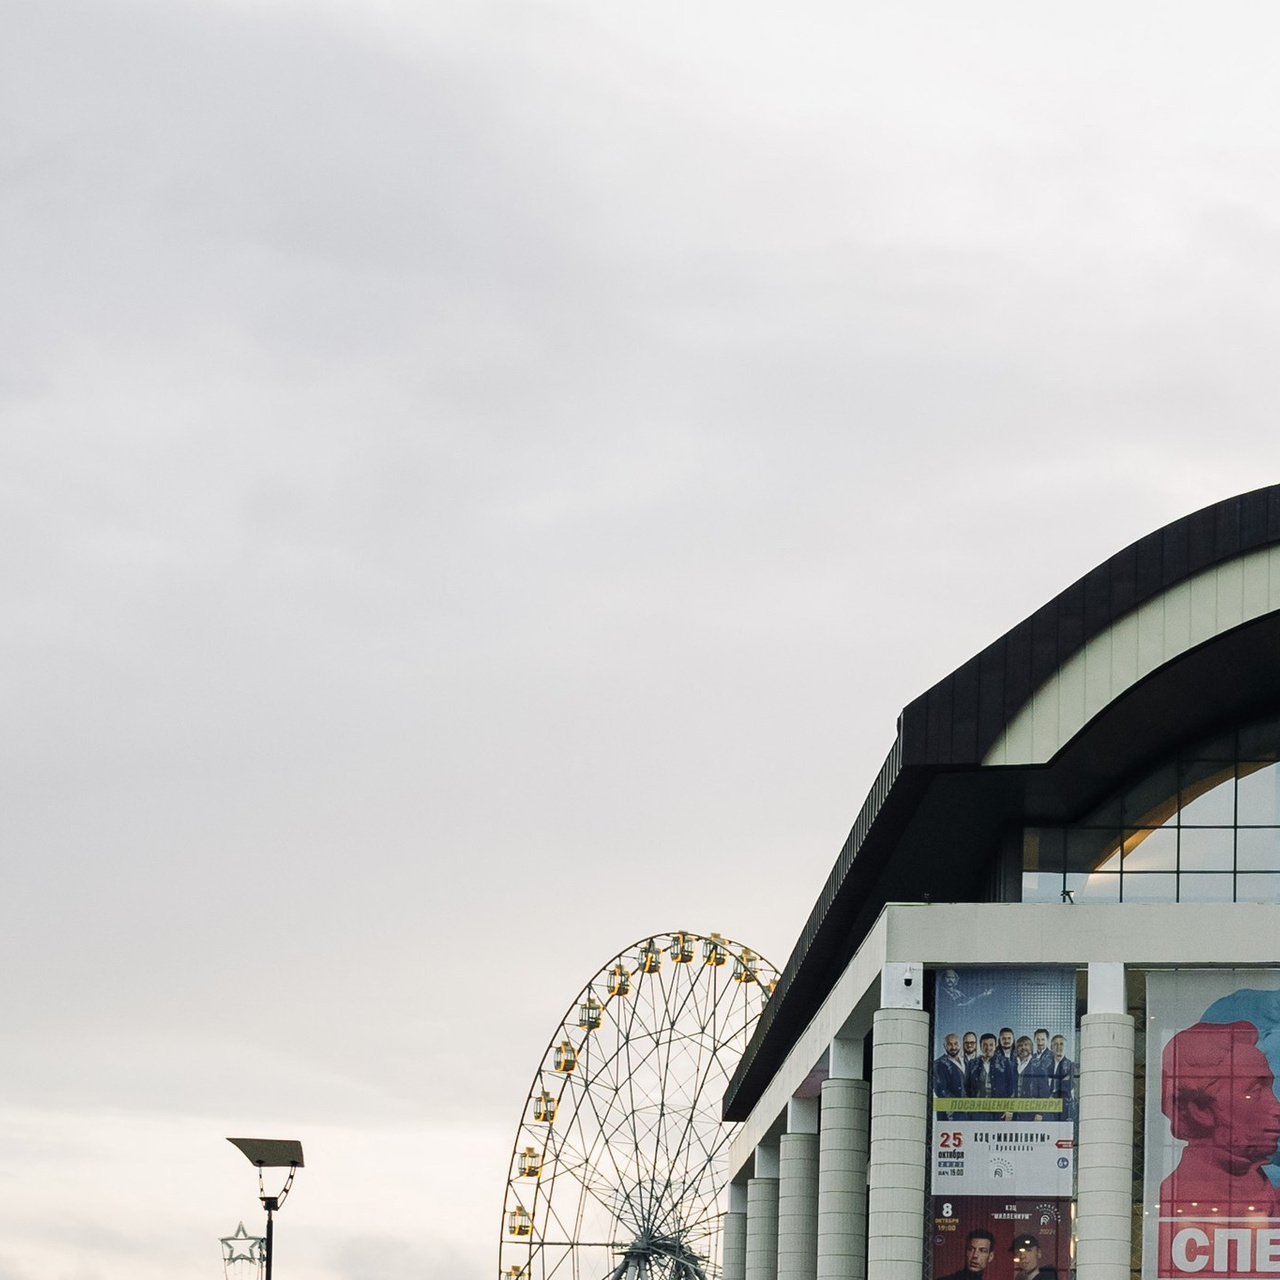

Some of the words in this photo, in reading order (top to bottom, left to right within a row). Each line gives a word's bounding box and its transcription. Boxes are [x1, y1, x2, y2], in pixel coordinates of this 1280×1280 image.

[950, 1099, 1015, 1110] ПОСВЯЩЕНИЕ
[940, 1132, 963, 1148] 25
[938, 1149, 964, 1160] октября
[942, 1202, 953, 1217] 8
[1005, 1204, 1017, 1212] КЗЦ
